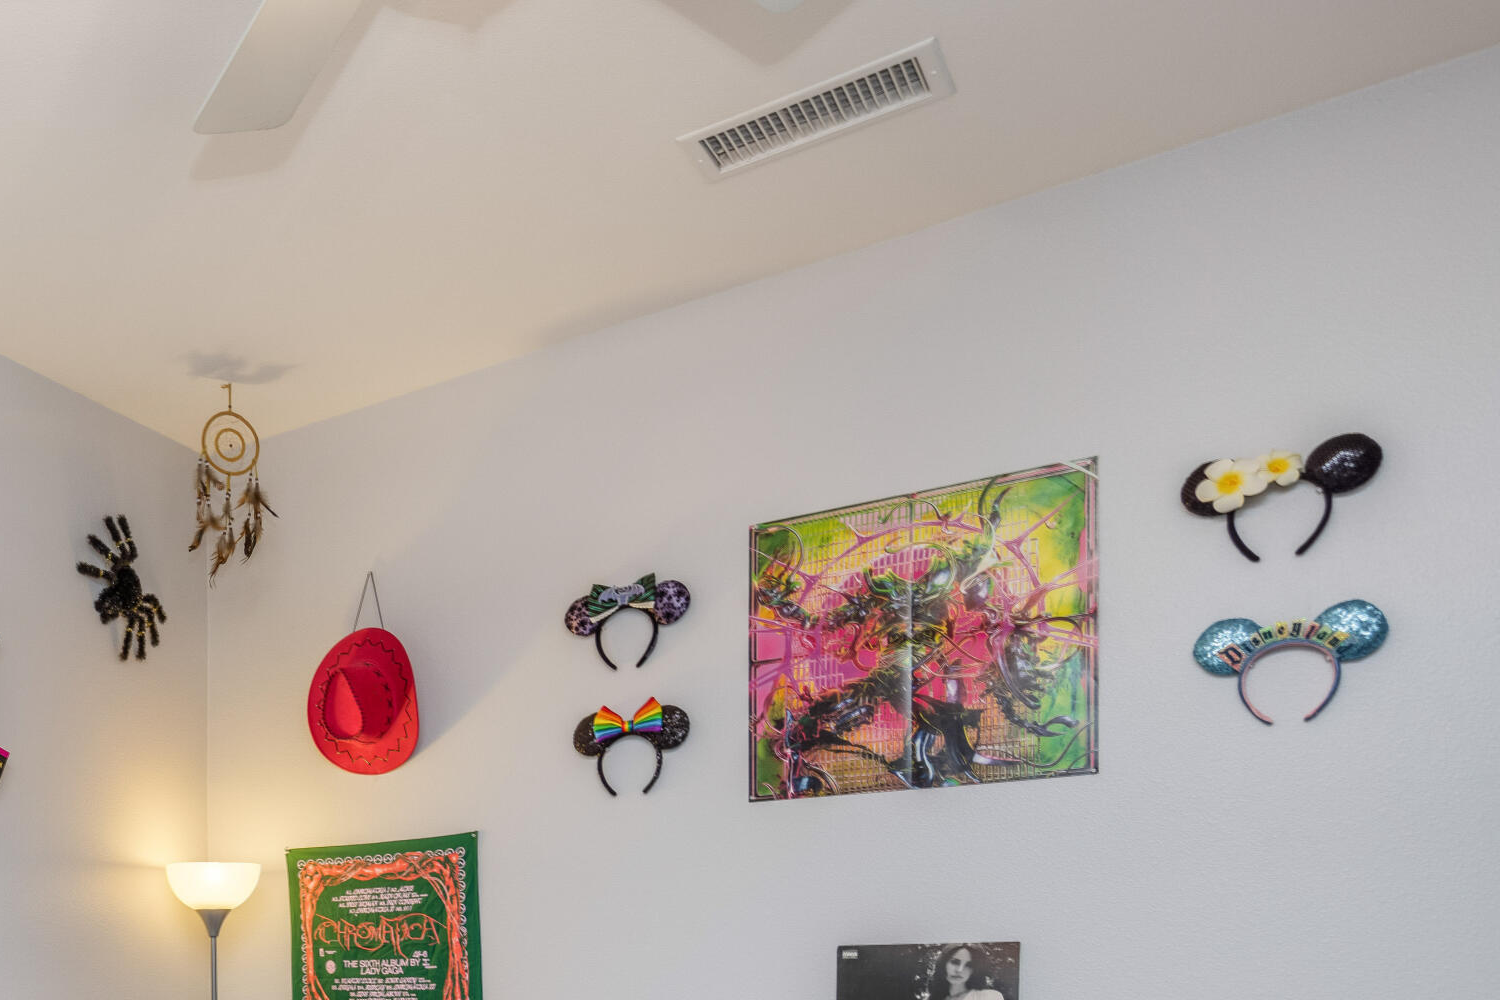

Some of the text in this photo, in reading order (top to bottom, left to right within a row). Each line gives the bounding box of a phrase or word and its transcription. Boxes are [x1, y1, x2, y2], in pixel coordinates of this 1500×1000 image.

[1218, 622, 1346, 665] Disneylan
[343, 959, 359, 968] THE
[360, 959, 380, 968] SIXTH
[381, 958, 409, 967] ALBUM
[410, 958, 421, 967] BY
[360, 966, 404, 975] LADY GAGA
